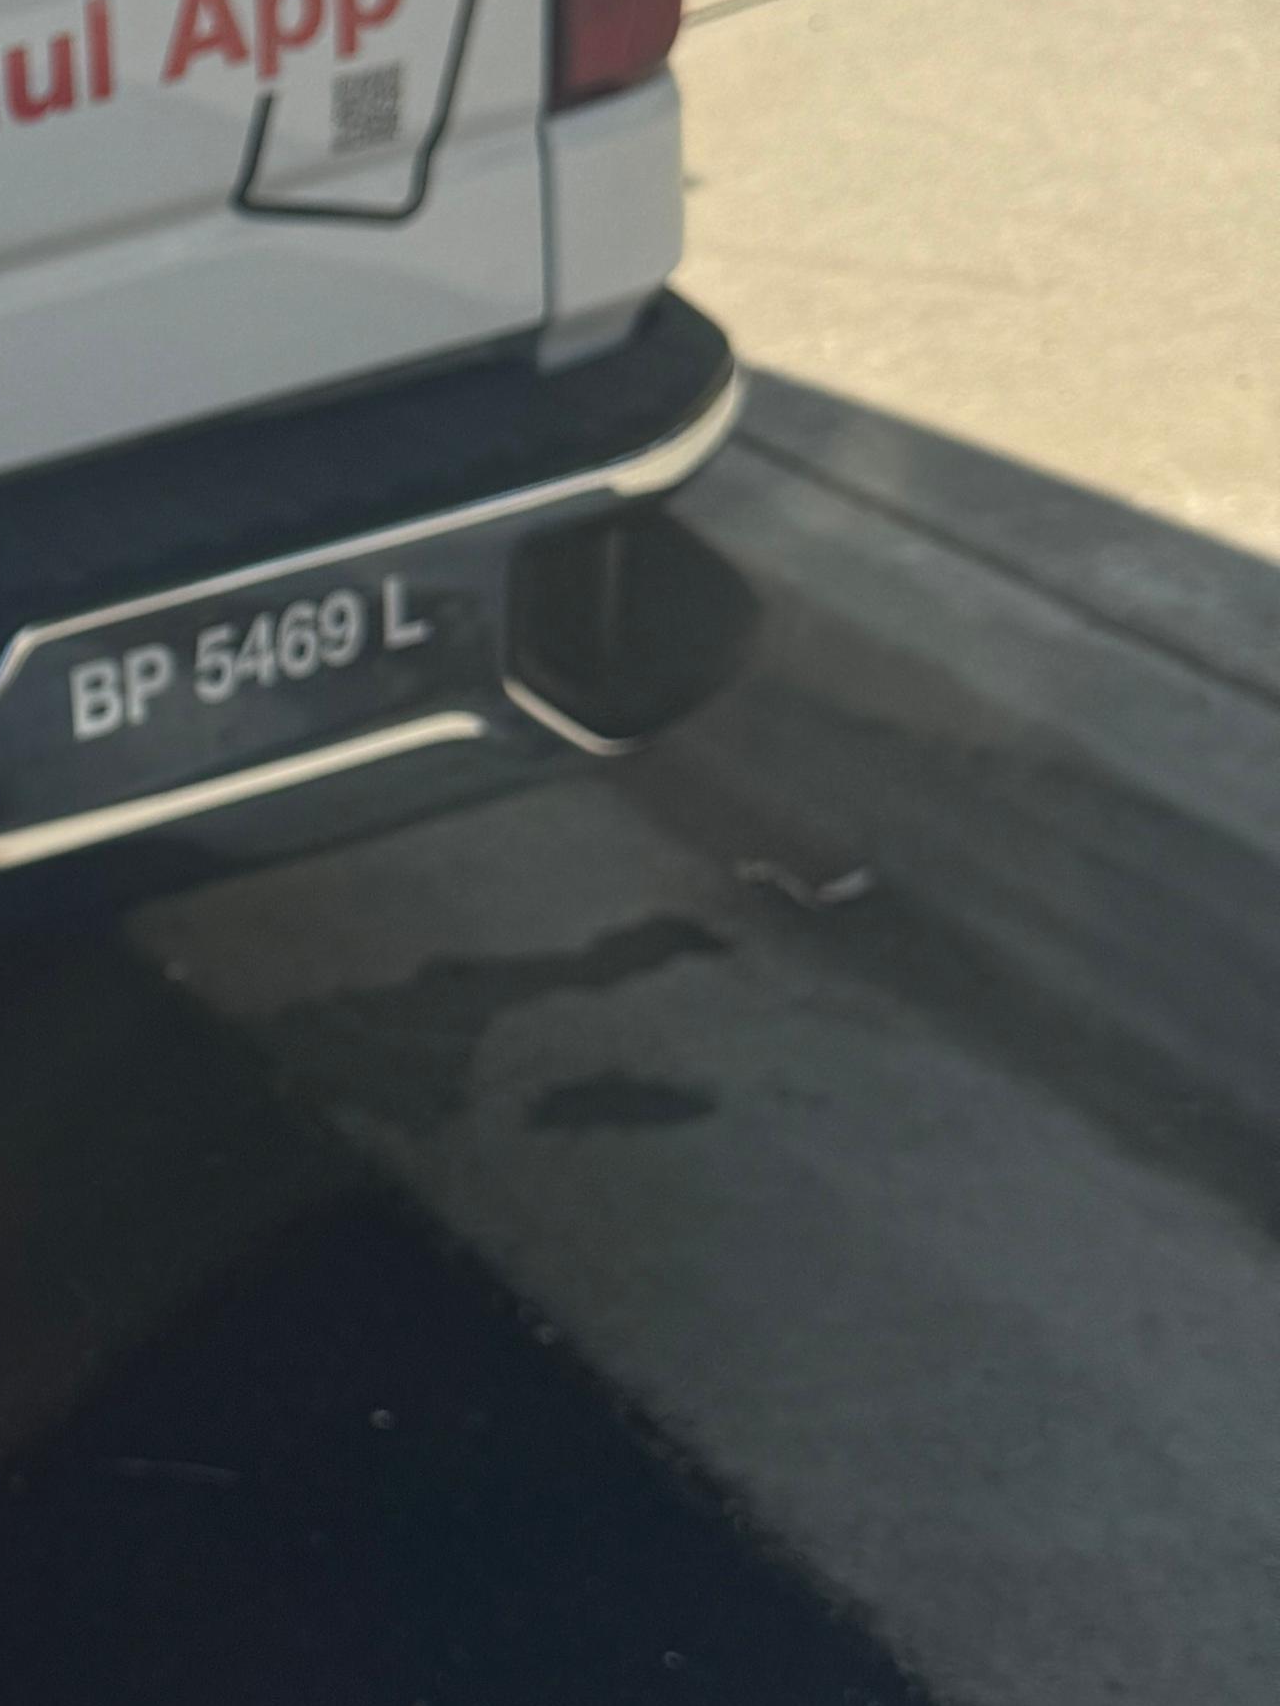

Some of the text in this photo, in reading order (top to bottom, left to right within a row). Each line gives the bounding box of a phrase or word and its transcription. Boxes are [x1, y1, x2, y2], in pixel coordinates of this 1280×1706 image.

[68, 573, 434, 742] BP 5469 L
